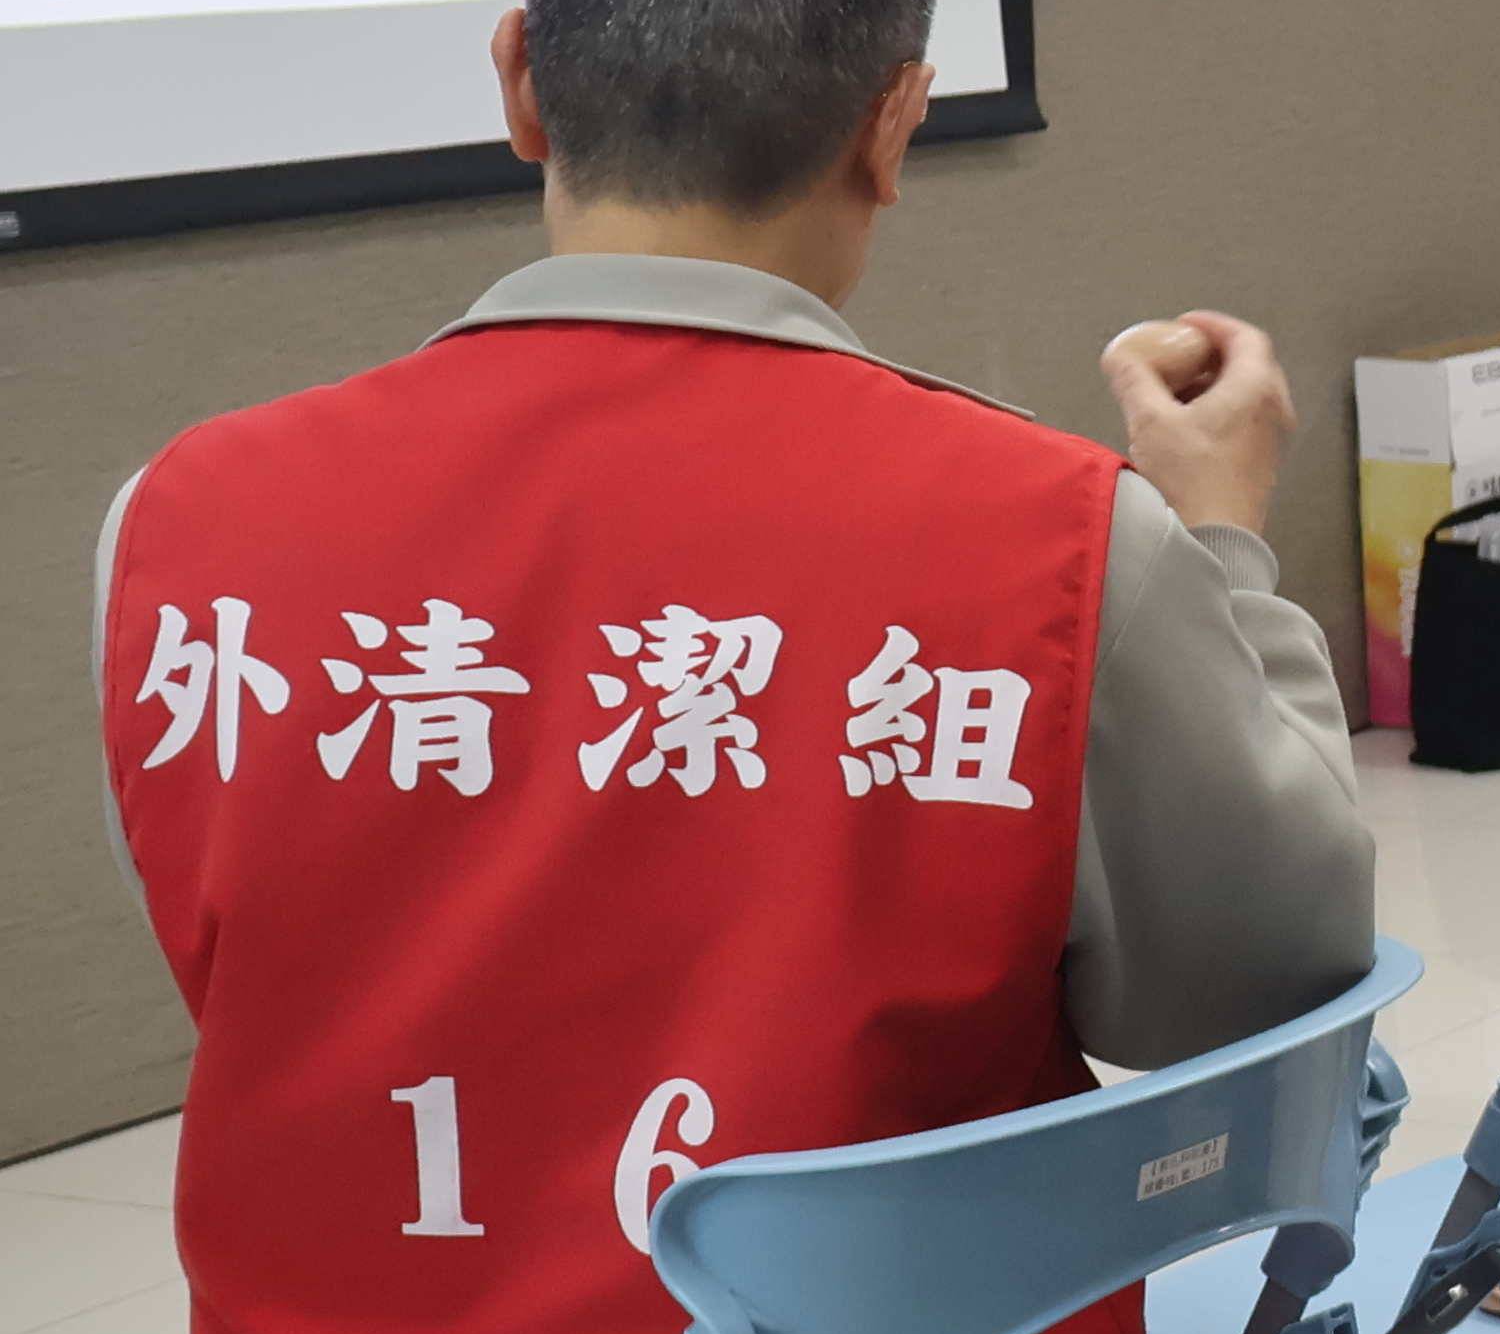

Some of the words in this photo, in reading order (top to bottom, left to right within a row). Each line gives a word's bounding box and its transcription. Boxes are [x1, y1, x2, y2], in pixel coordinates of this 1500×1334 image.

[136, 597, 1034, 810] 外清潔組
[390, 1075, 716, 1255] 16
